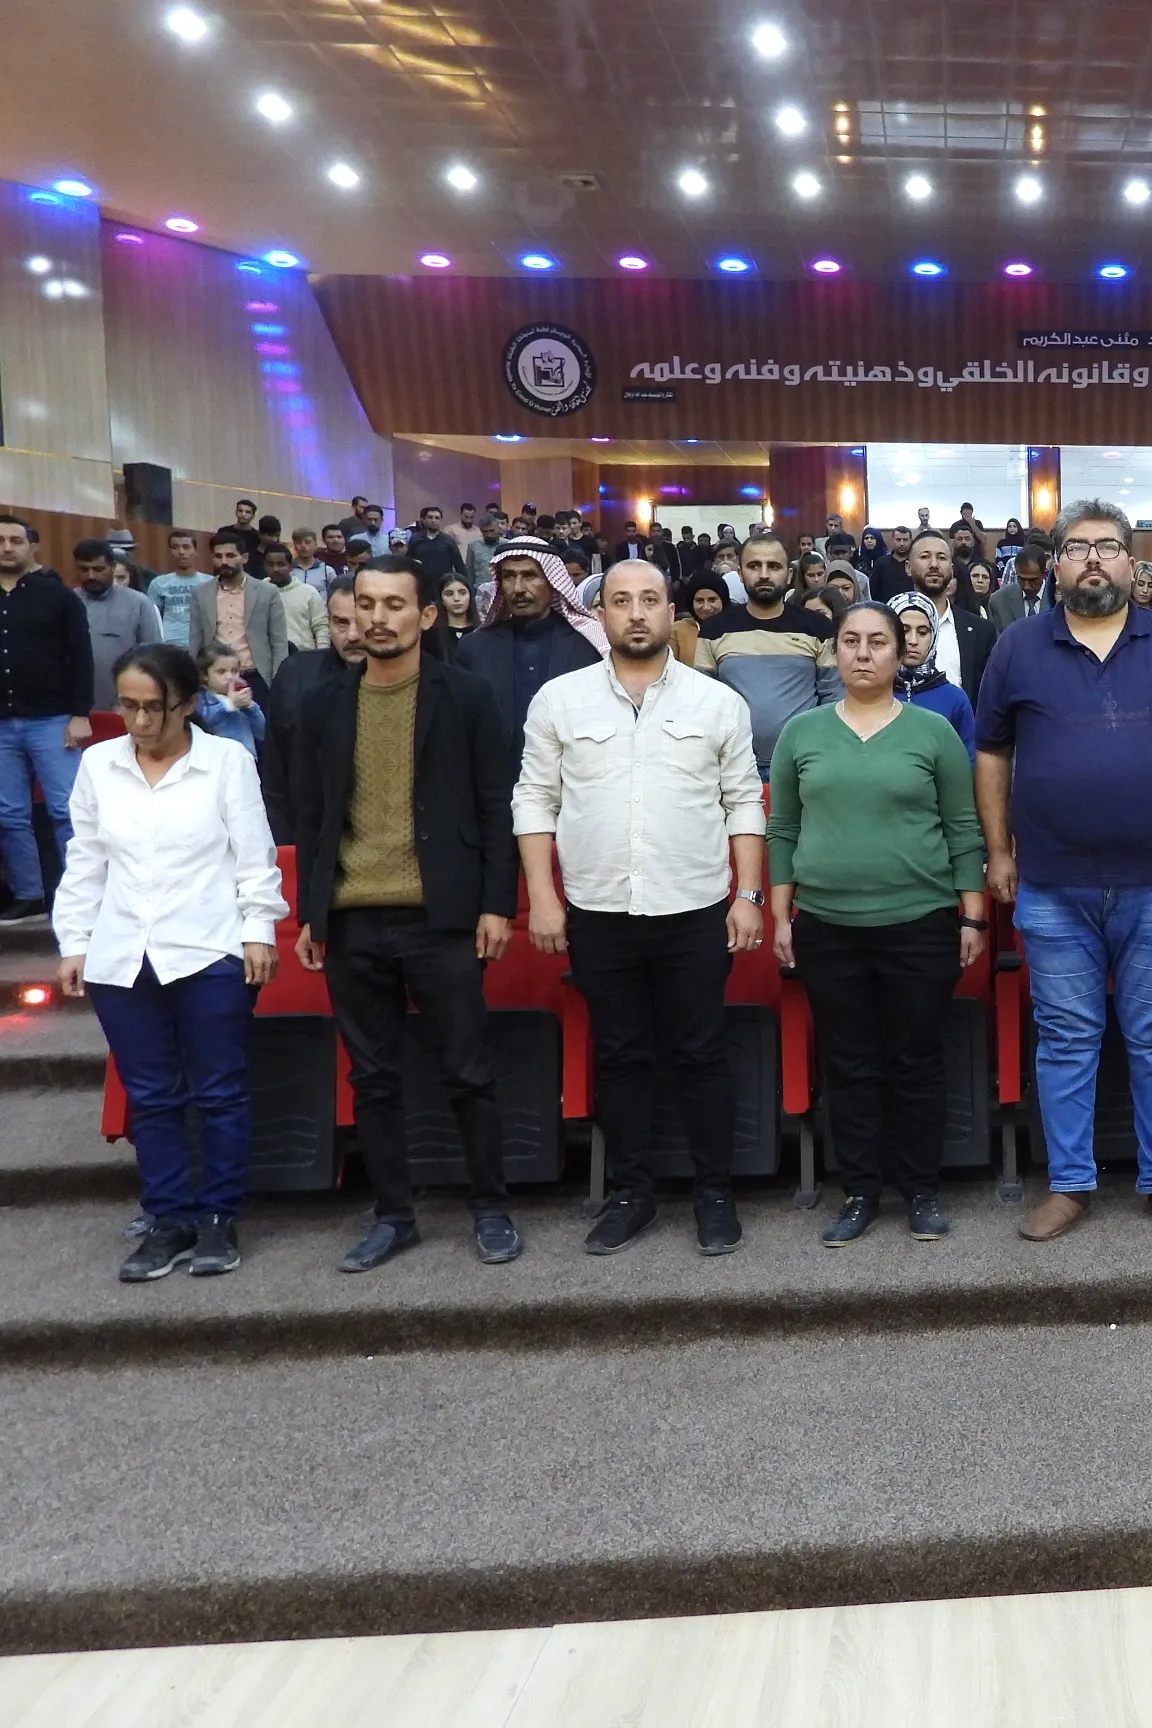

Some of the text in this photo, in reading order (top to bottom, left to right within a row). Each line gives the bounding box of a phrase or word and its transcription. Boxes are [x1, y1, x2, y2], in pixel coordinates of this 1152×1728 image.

[1100, 331, 1139, 348] مثنى
[630, 355, 722, 385] وعلمه
[725, 358, 801, 386] وفنه
[803, 360, 934, 388] وذهنيته
[936, 359, 1035, 392] الخلقي
[1037, 360, 1150, 389] وقانونه
